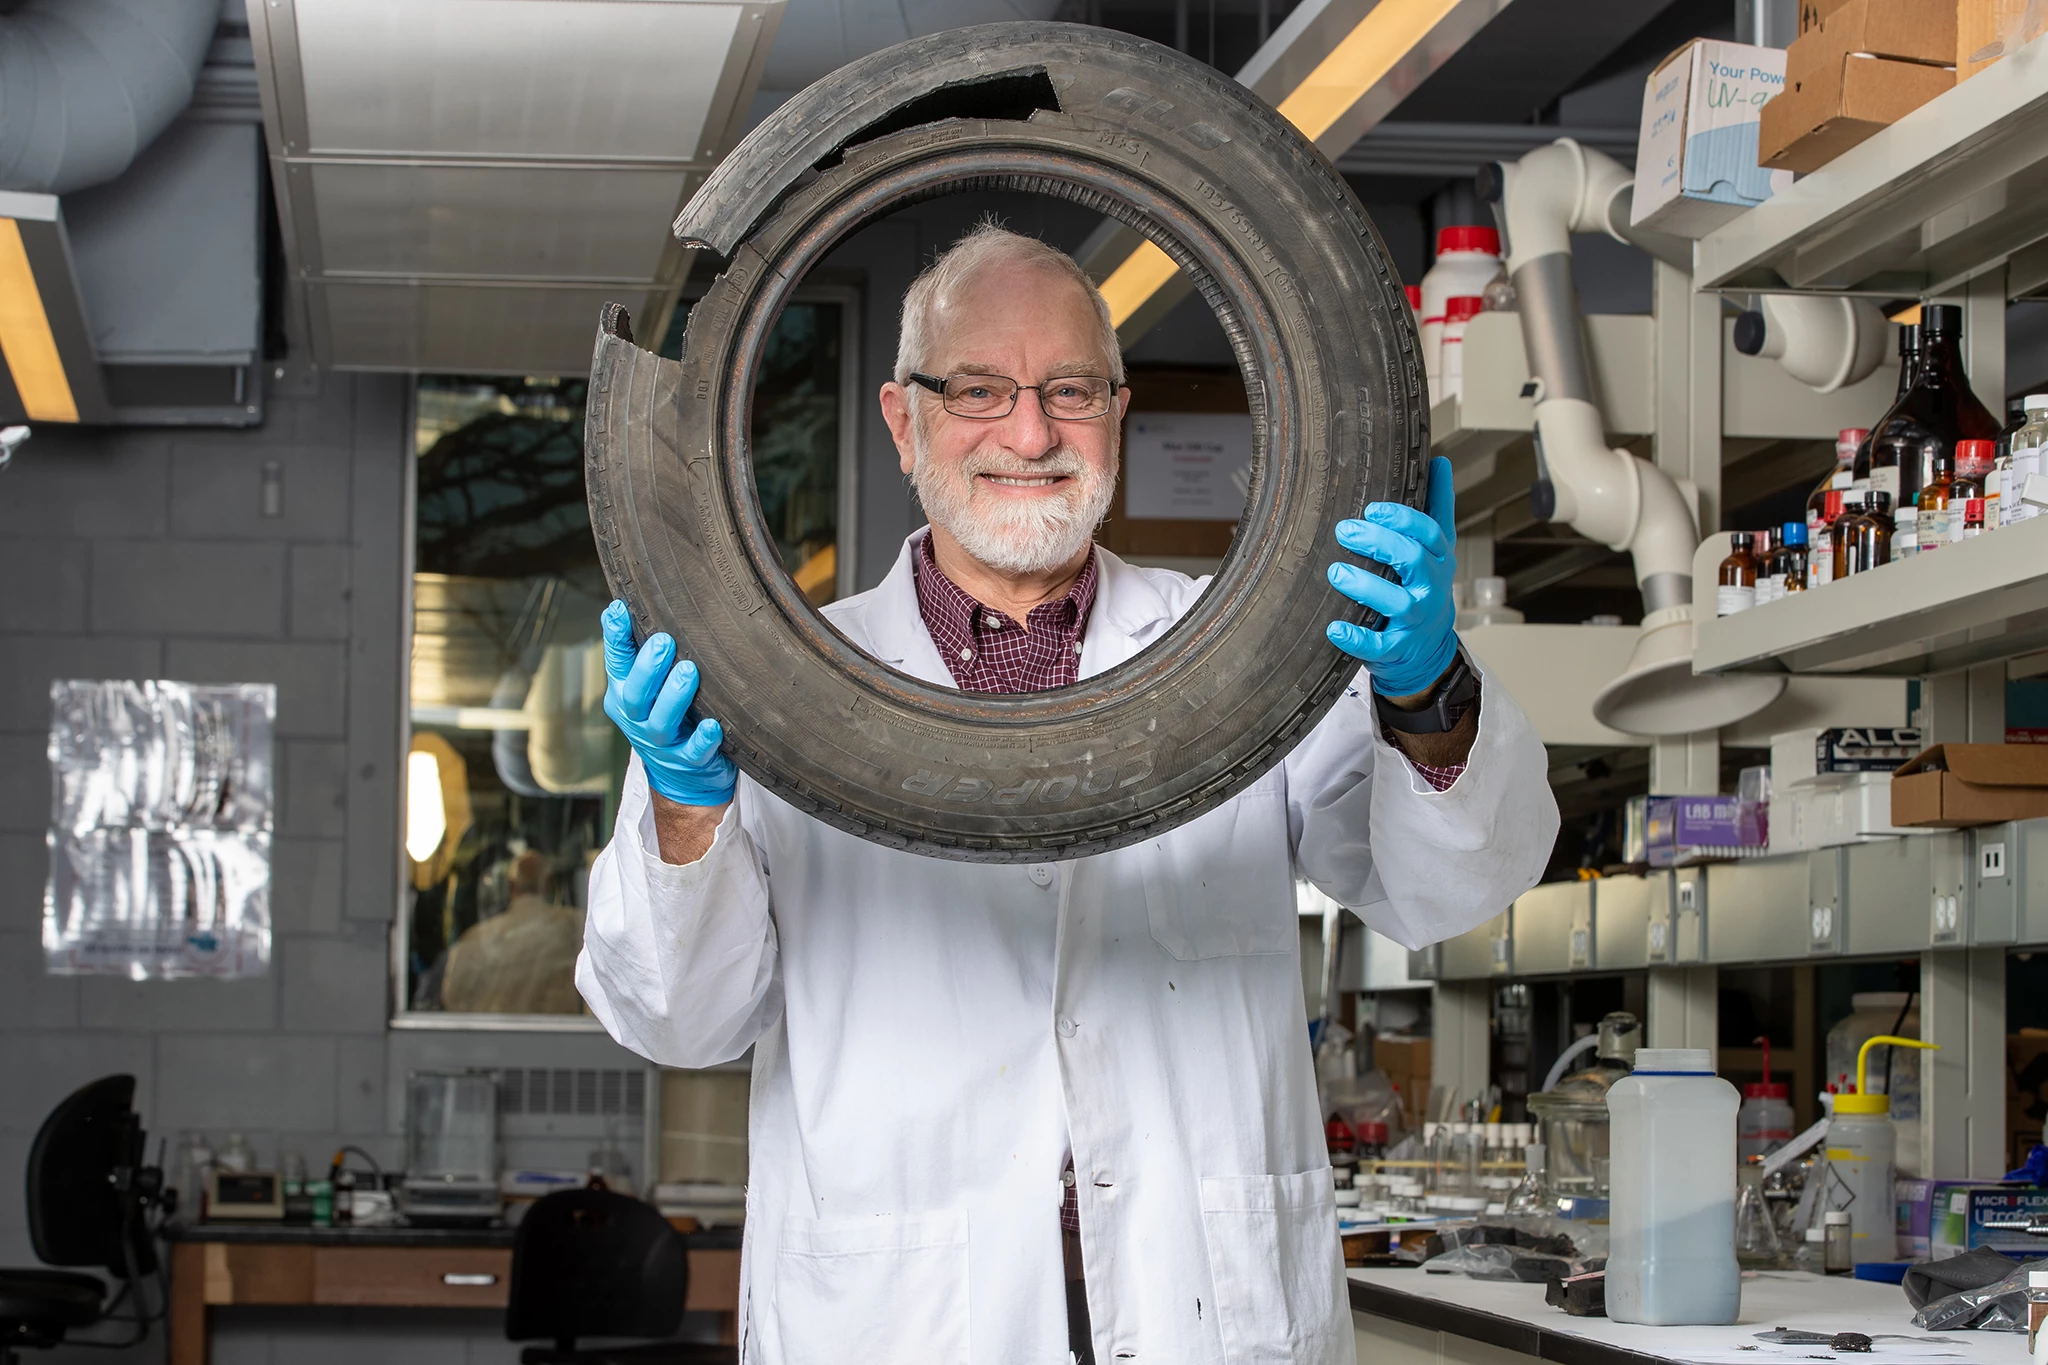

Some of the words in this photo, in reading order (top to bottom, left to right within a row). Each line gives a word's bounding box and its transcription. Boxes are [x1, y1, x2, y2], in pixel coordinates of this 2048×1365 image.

[1709, 61, 1745, 79] Your
[1101, 86, 1232, 150] GLS
[1096, 130, 1140, 155] M+S
[851, 152, 888, 175] TUBELESS
[1192, 178, 1276, 264] 185/65R14
[696, 379, 708, 400] DOT
[1393, 440, 1402, 478] TRACTION
[901, 748, 1160, 805] COOPER
